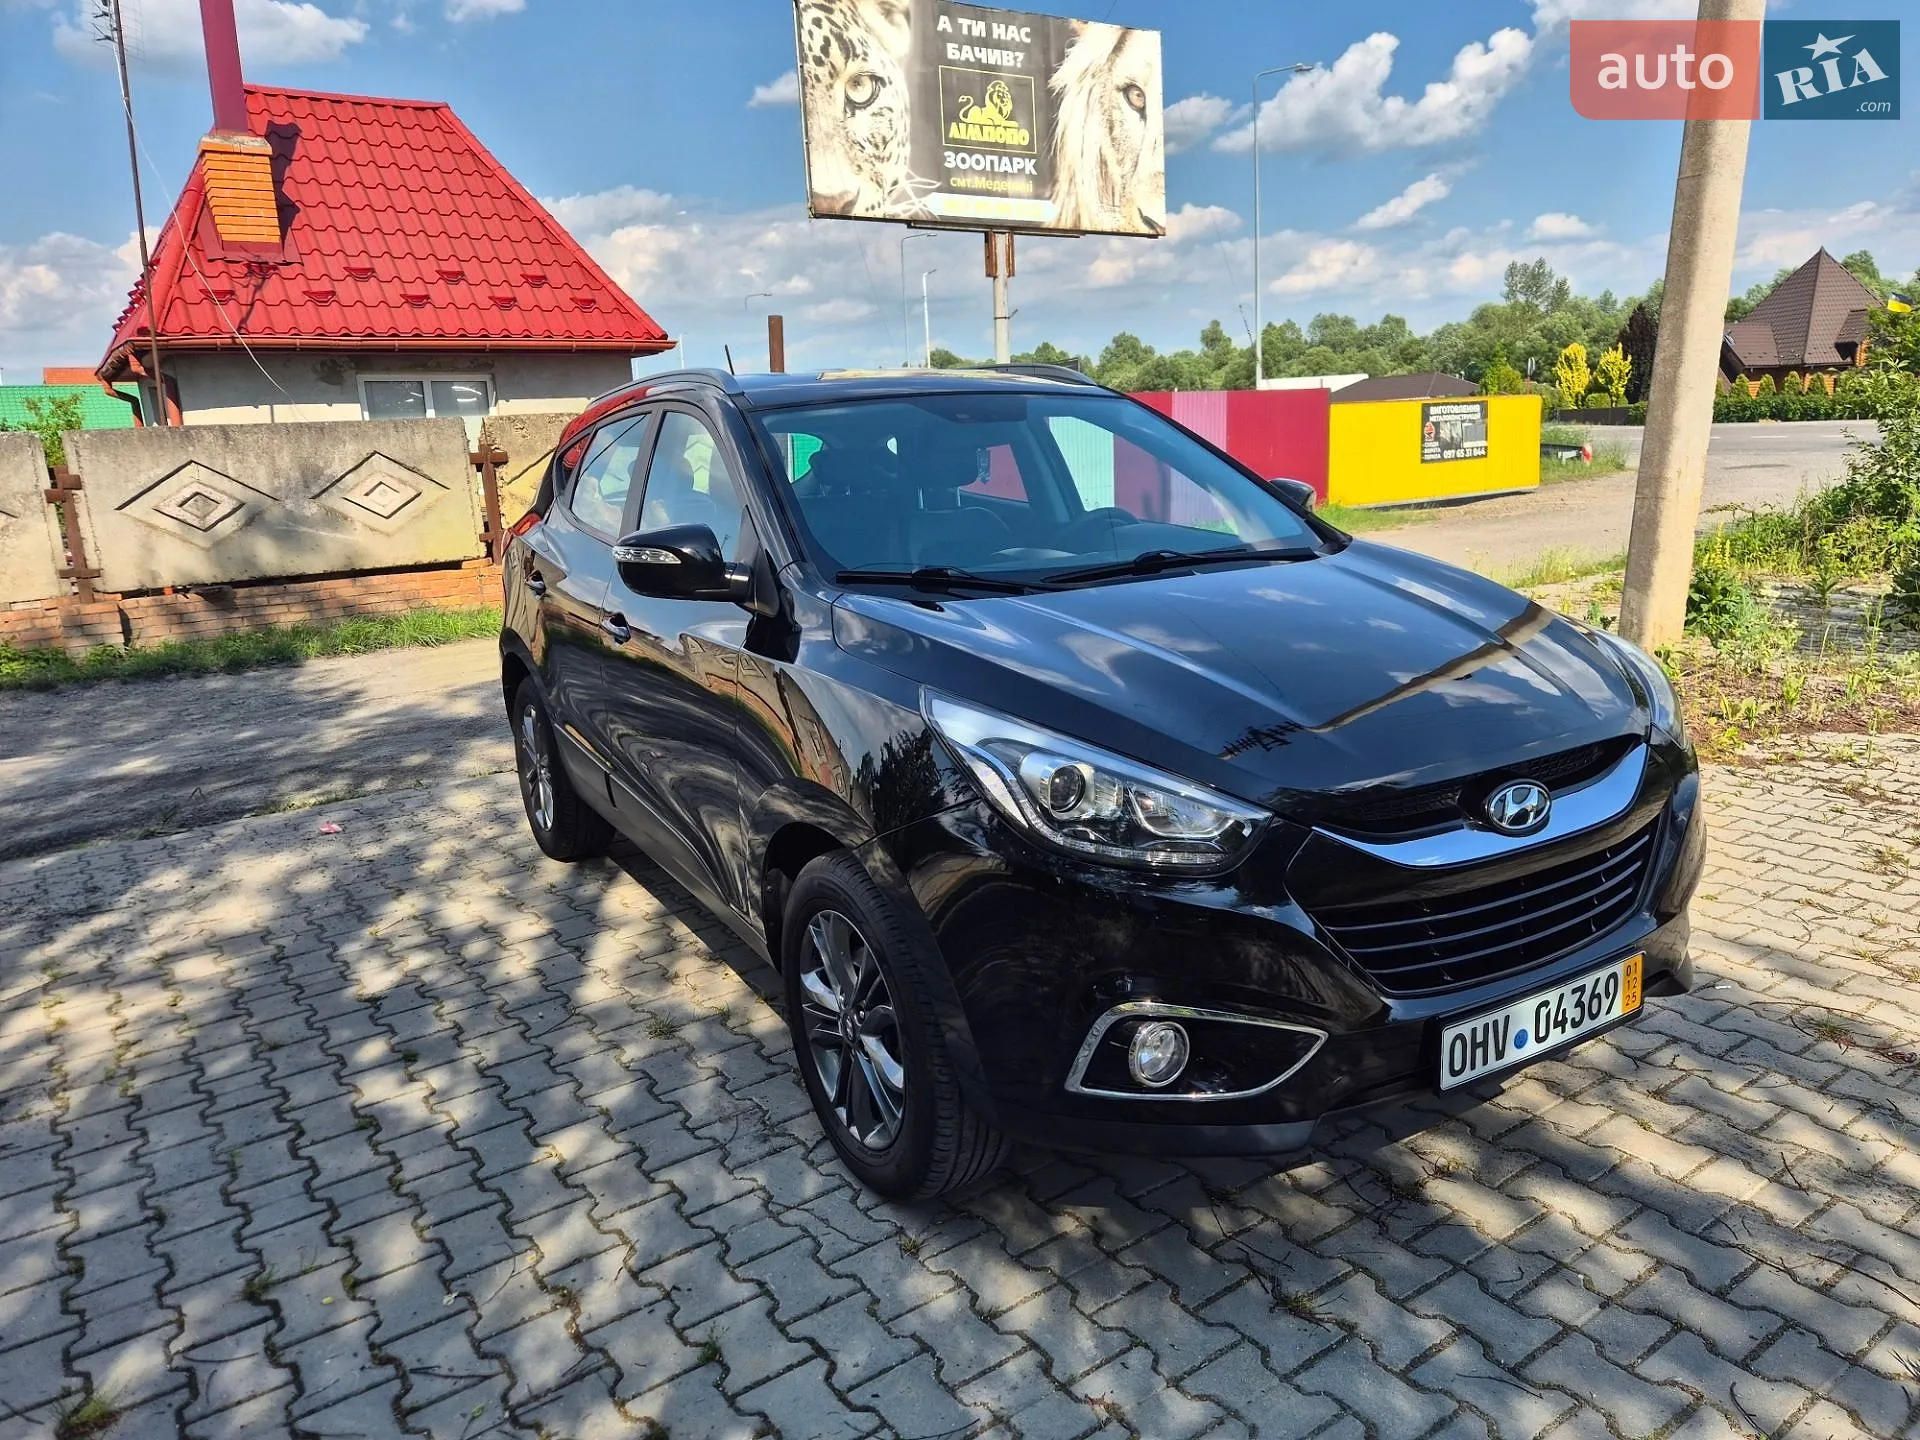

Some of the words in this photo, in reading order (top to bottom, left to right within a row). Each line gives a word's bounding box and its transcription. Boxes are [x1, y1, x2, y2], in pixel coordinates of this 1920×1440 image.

[937, 15, 952, 33] А
[957, 18, 986, 38] ТИ
[992, 22, 1031, 43] НАС
[946, 42, 1025, 68] БАЧИВ?
[949, 122, 1030, 146] ЛІМПОПО
[943, 151, 1038, 175] ЗООПАРК
[1626, 962, 1638, 977] 01
[1627, 977, 1638, 990] 12
[1625, 991, 1637, 1007] 25
[1450, 1014, 1511, 1078] OHV
[1534, 971, 1619, 1044] 04369
